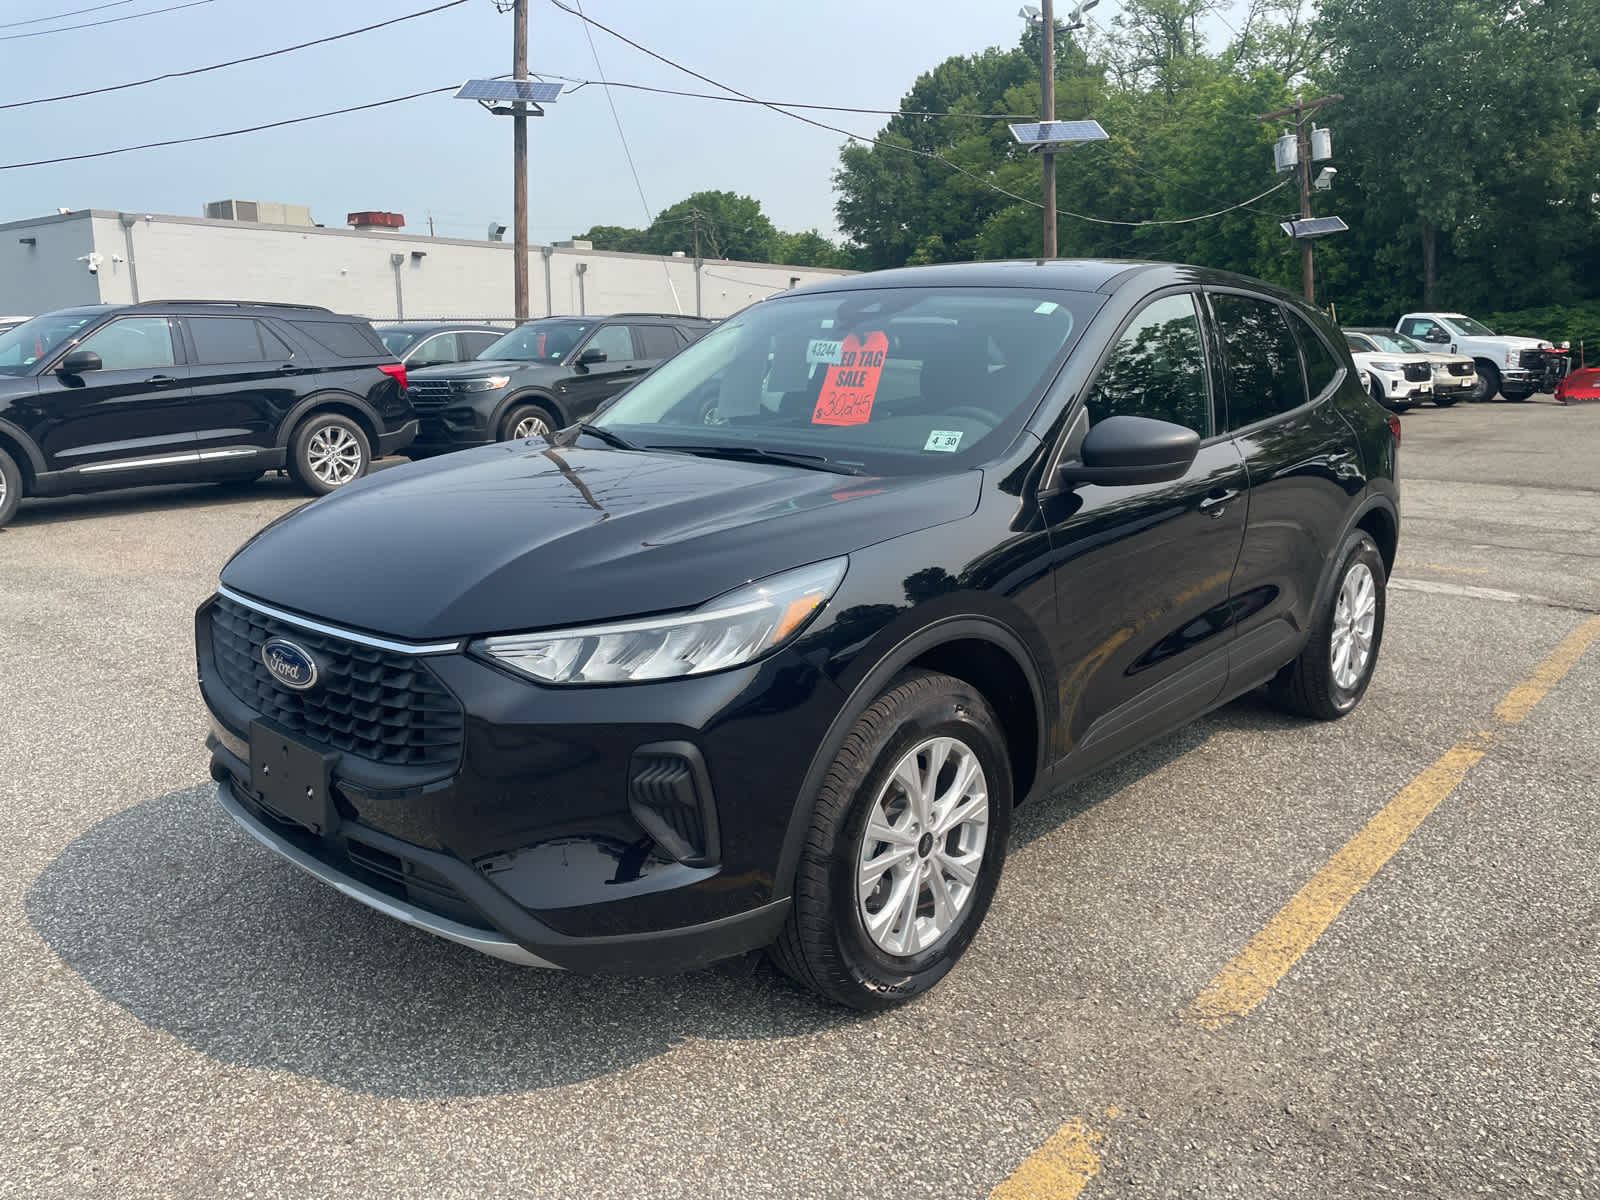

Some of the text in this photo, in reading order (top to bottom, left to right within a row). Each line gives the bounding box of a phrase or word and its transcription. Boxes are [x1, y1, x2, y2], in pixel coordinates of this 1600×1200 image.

[811, 342, 838, 358] 43244
[832, 349, 884, 369] ED TAG
[835, 370, 868, 388] SALE
[932, 436, 957, 446] 4 30
[270, 648, 300, 680] Ford
